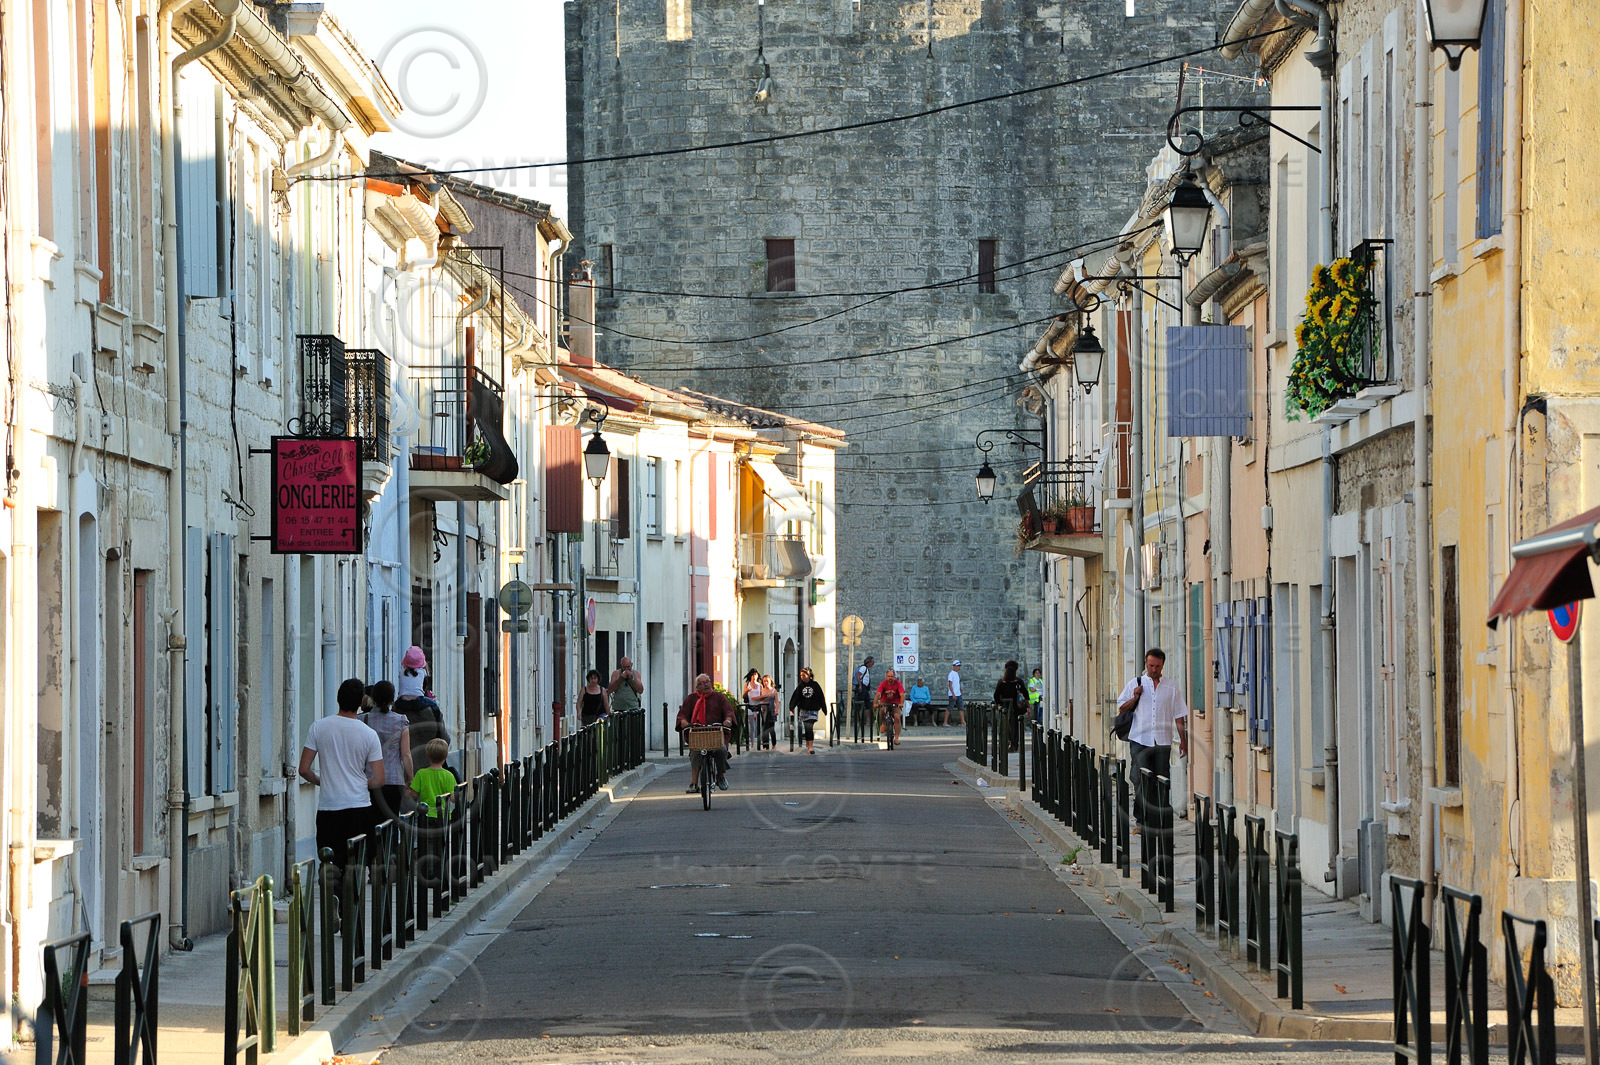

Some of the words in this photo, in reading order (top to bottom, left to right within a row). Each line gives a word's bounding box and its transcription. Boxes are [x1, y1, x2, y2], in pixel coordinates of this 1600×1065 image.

[279, 484, 356, 509] ONGLERIE
[285, 516, 297, 525] 06
[301, 516, 310, 525] 15
[314, 516, 324, 525] 47
[327, 516, 335, 524] 11
[338, 516, 348, 524] 44
[300, 528, 334, 536] ENTREE
[278, 539, 294, 547] Rue
[297, 539, 311, 547] des
